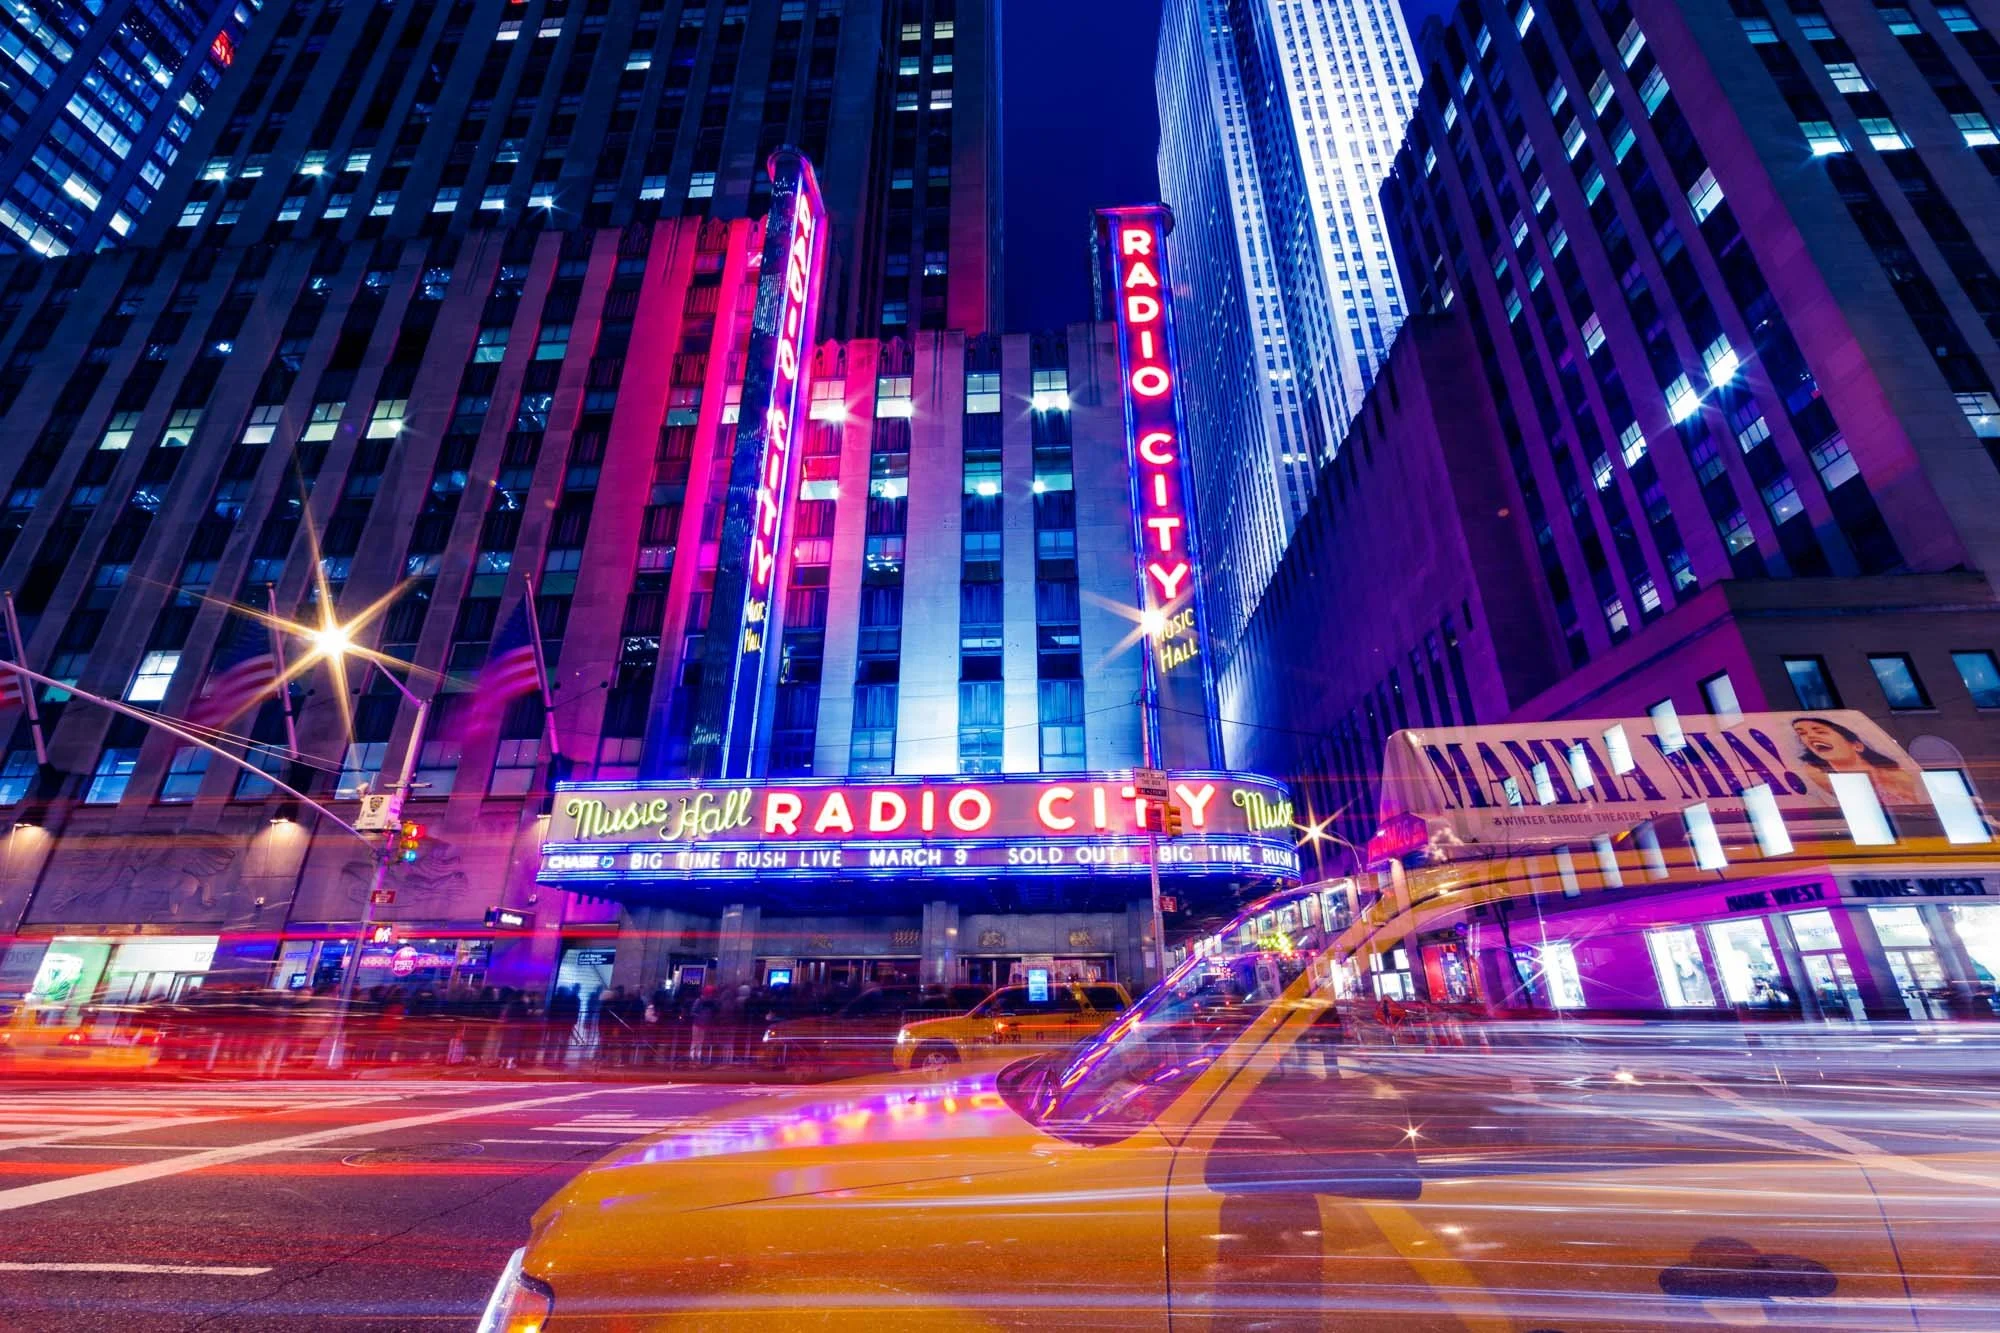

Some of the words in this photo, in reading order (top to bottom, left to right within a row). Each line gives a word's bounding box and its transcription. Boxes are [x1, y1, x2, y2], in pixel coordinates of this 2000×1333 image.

[1123, 229, 1169, 396] RADIO
[1140, 433, 1188, 599] CITY
[1641, 728, 1808, 799] MIA!
[566, 798, 668, 840] Music
[659, 787, 752, 841] Hall
[765, 788, 991, 835] RADIO
[1038, 784, 1215, 831] CITY
[1503, 814, 1547, 826] WINTER
[1549, 813, 1593, 825] GARDEN
[548, 855, 600, 869] CHASE
[630, 852, 663, 870] BIG
[676, 851, 720, 869] TIME
[735, 850, 786, 868] RUSH
[800, 850, 842, 867] LIVE
[869, 849, 942, 867] MARCH
[954, 849, 967, 865] 9
[1007, 846, 1063, 865] SOLD
[1159, 844, 1193, 863] BIG
[1208, 845, 1252, 863] TIME
[1262, 847, 1293, 868] RUSH
[1725, 890, 1769, 912] NINE
[1770, 882, 1825, 905] WEST
[1850, 878, 1918, 897] NINE
[1917, 877, 1987, 896] WEST
